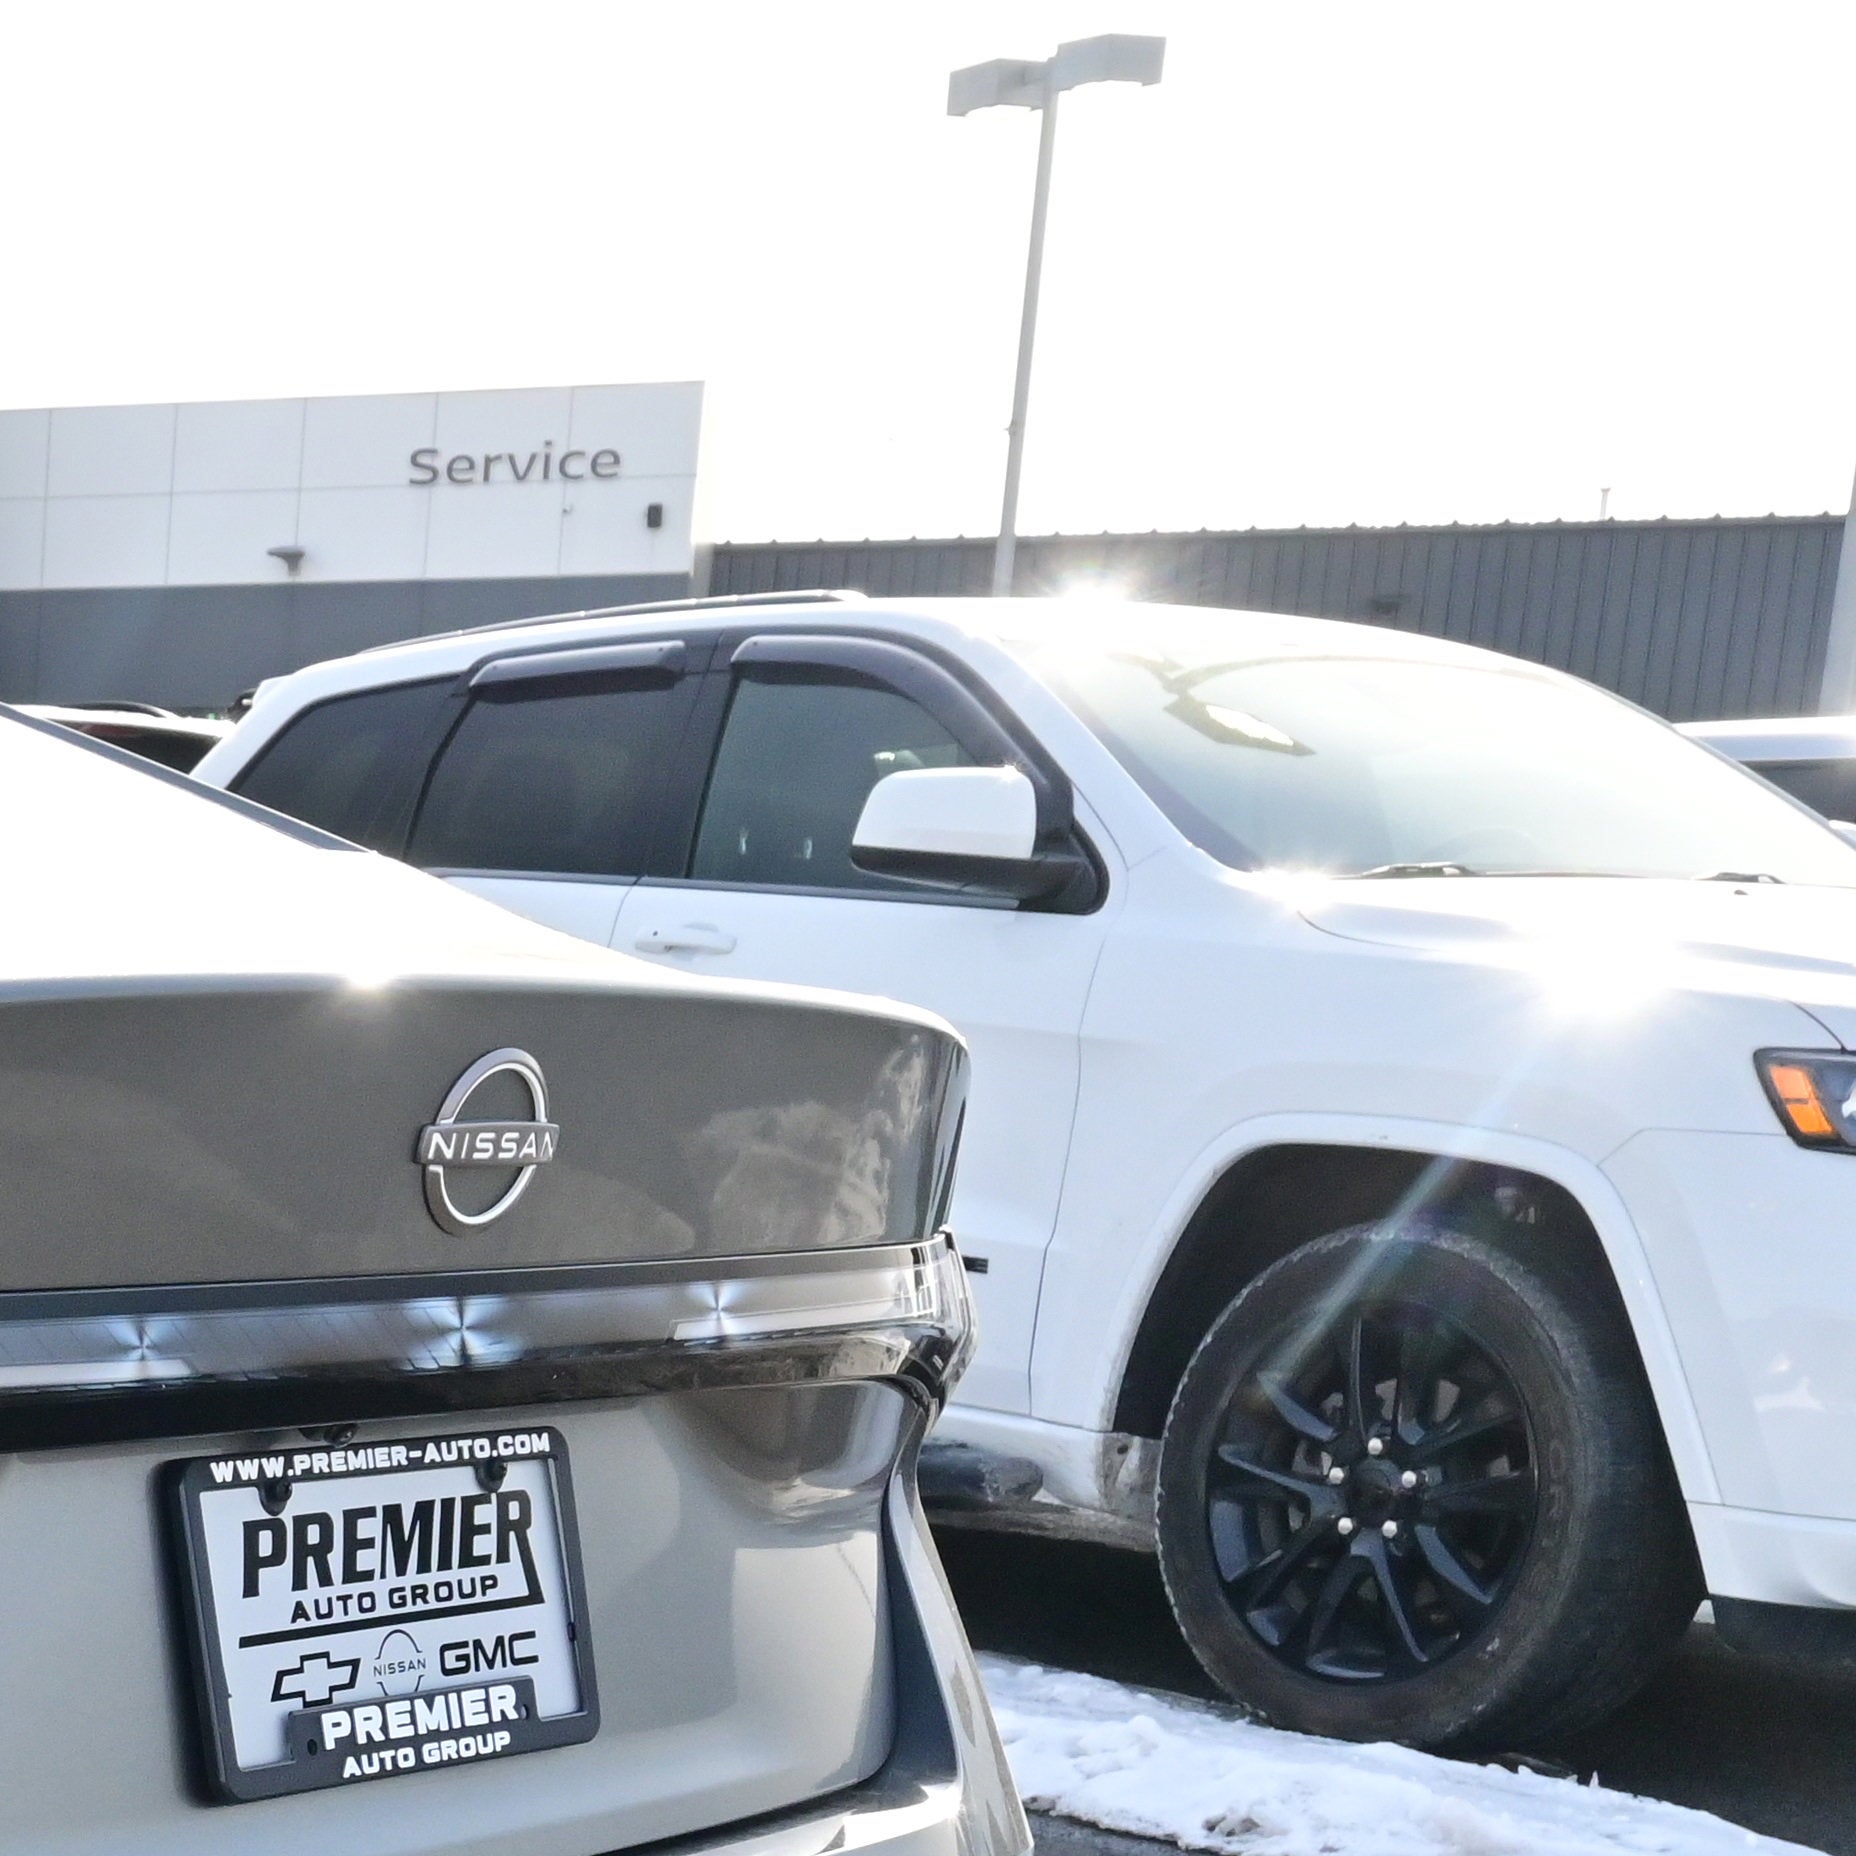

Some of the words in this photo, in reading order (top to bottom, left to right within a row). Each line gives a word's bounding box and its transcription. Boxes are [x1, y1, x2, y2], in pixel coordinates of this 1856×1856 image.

[406, 437, 625, 490] Service
[428, 1123, 561, 1163] NISSAN
[210, 1432, 551, 1483] WWW.PREMIER-AUTO.COM
[241, 1489, 538, 1600] PREMIER
[290, 1592, 376, 1624] AUTO
[388, 1573, 500, 1610] GROUP
[372, 1656, 427, 1678] NISSAN
[438, 1630, 540, 1677] GMC
[321, 1684, 519, 1751] PREMIER
[342, 1746, 415, 1778] AUTO
[422, 1731, 512, 1764] GROUP
